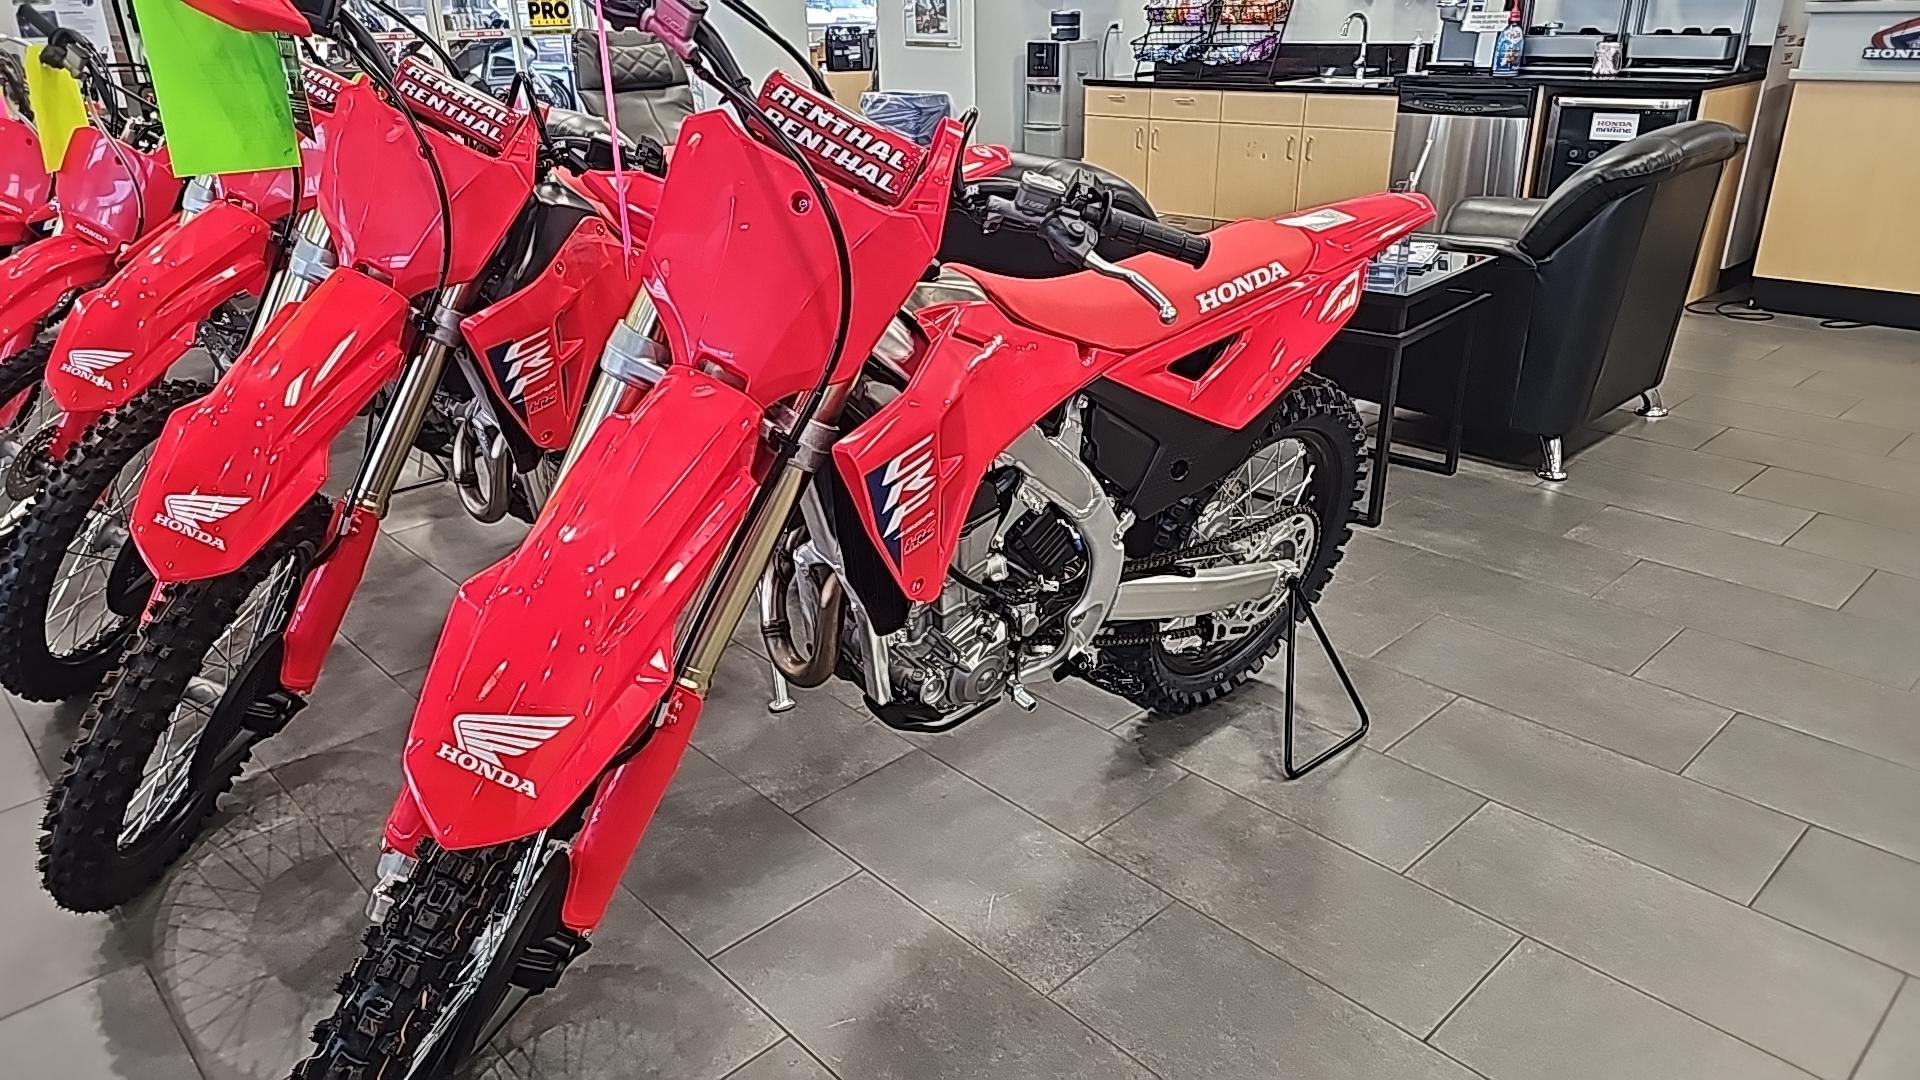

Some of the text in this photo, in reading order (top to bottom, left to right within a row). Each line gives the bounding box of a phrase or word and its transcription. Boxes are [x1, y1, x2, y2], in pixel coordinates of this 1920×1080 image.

[528, 1, 569, 19] PRO
[399, 79, 501, 142] RENTHAL
[406, 65, 508, 126] RENTHAL
[764, 107, 896, 194] RENTHAL
[770, 85, 905, 171] RENTHAL
[75, 223, 109, 245] HONDA
[1196, 261, 1291, 314] HONDA
[60, 363, 114, 391] HONDA
[152, 512, 228, 551] HONDA
[435, 741, 538, 799] HONDA
